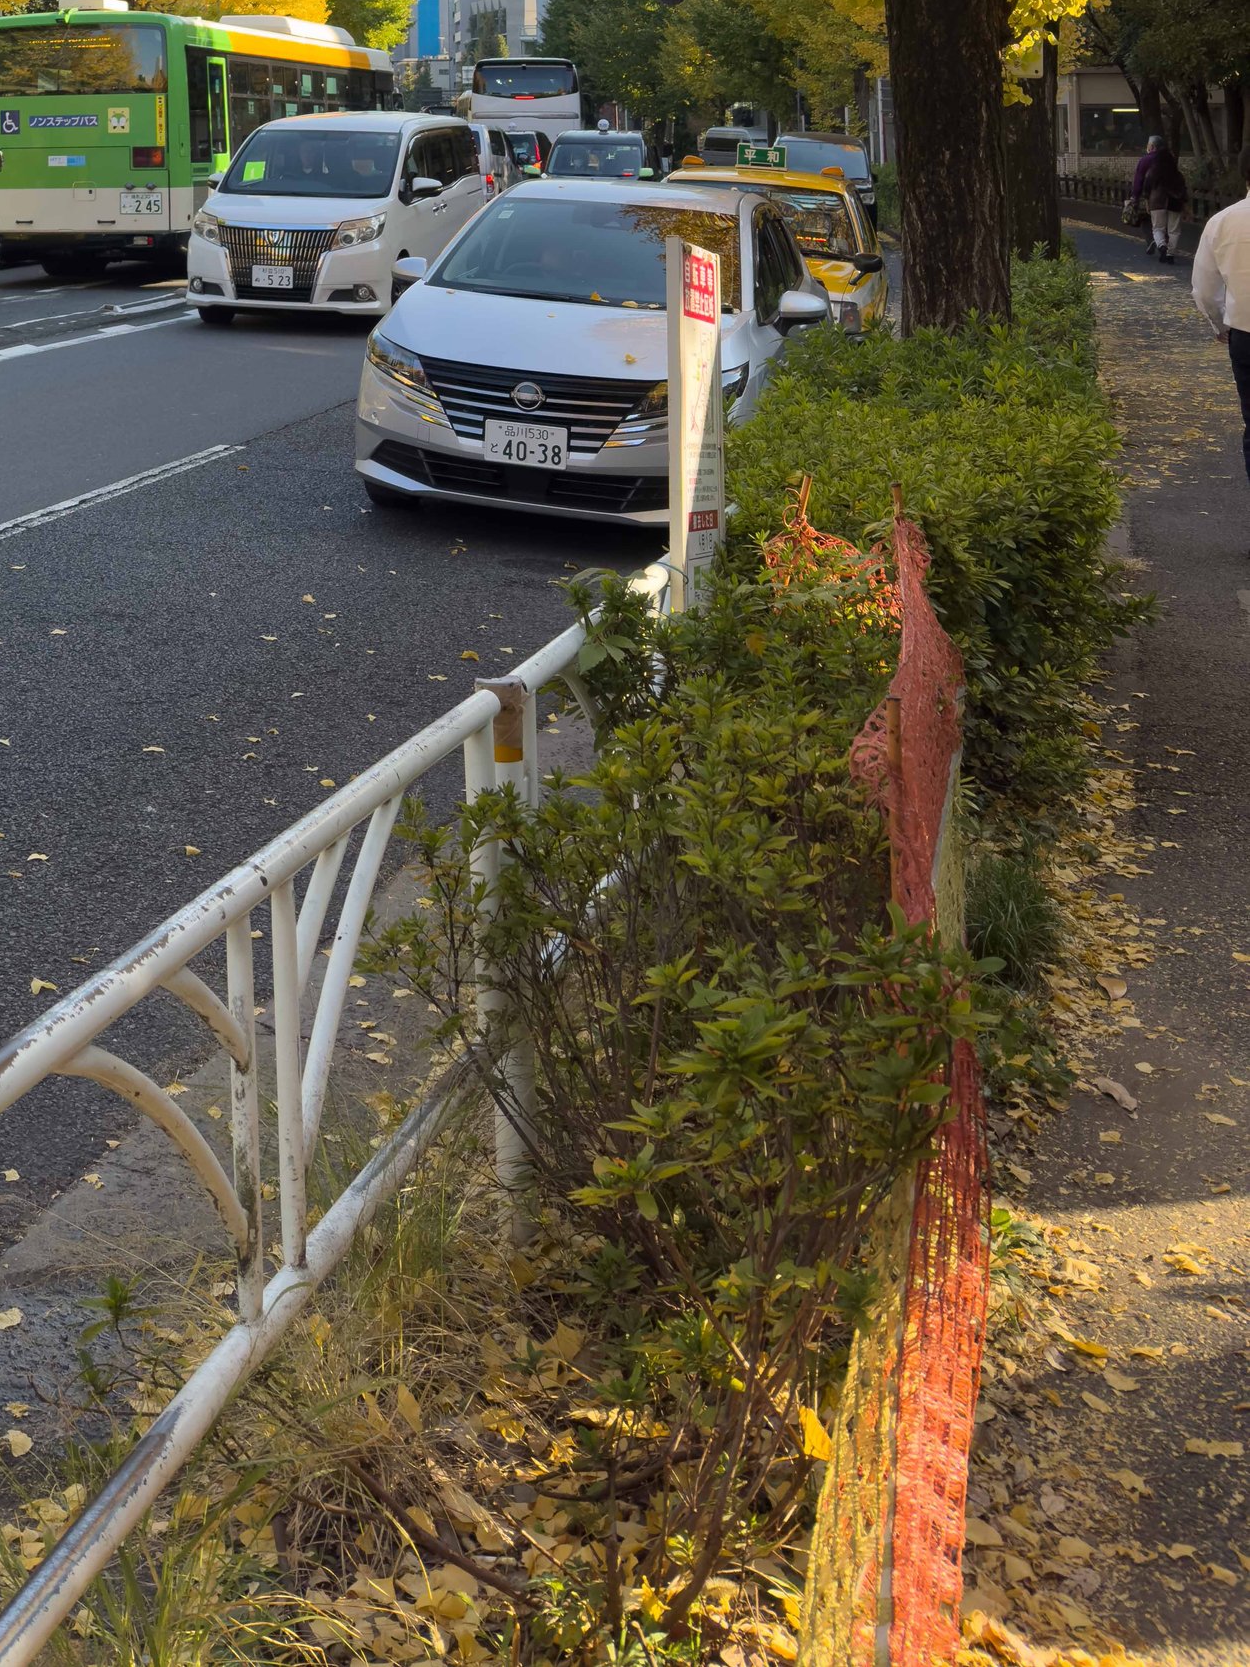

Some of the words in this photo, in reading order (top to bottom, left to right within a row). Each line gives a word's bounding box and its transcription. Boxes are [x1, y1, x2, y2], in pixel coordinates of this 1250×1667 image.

[30, 116, 98, 126] ノンステップバス
[743, 149, 780, 163] 平和
[502, 439, 562, 465] 40-38
